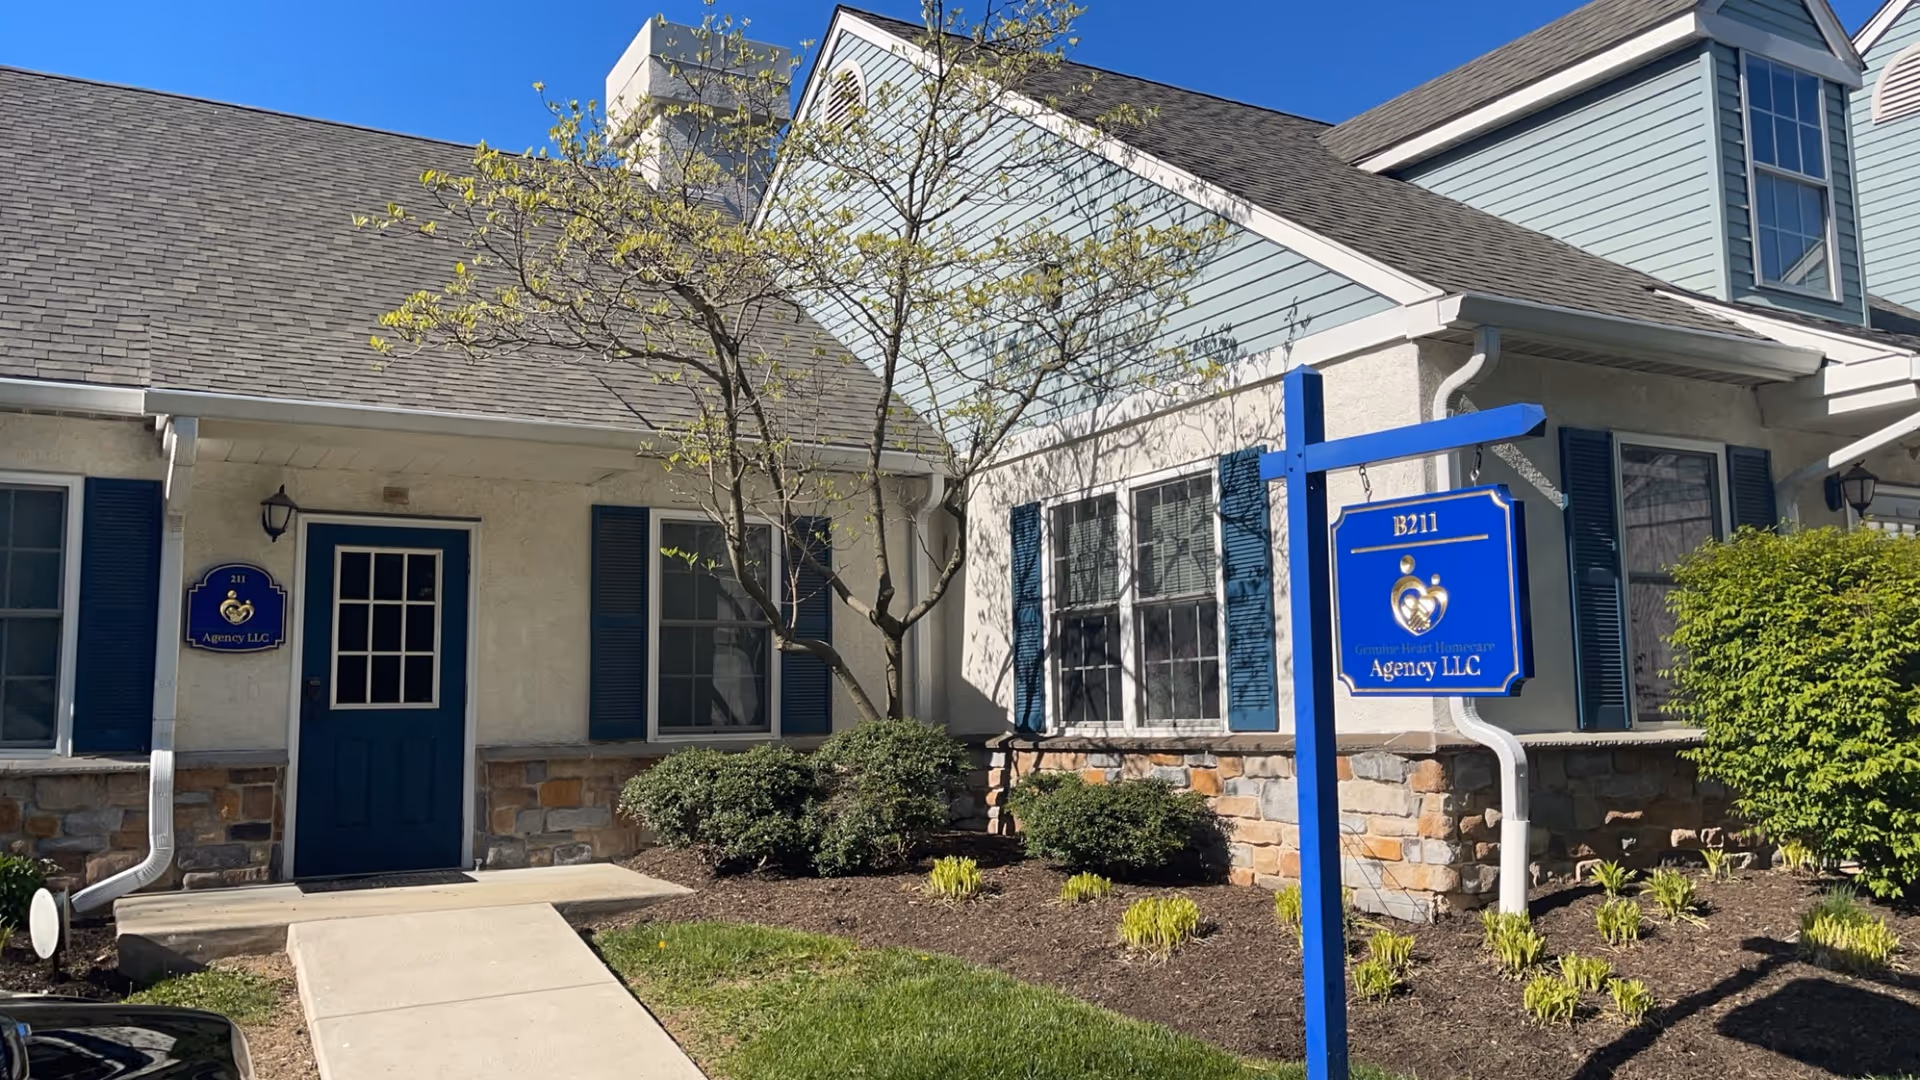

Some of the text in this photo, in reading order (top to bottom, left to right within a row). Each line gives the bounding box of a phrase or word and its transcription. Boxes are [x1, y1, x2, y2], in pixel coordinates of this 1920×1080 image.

[1393, 511, 1438, 536] B211
[230, 575, 246, 584] 211
[203, 633, 269, 644] Agency LLC
[1355, 640, 1495, 656] Genuine Heart Homecare
[1369, 655, 1481, 682] Agency LLC
